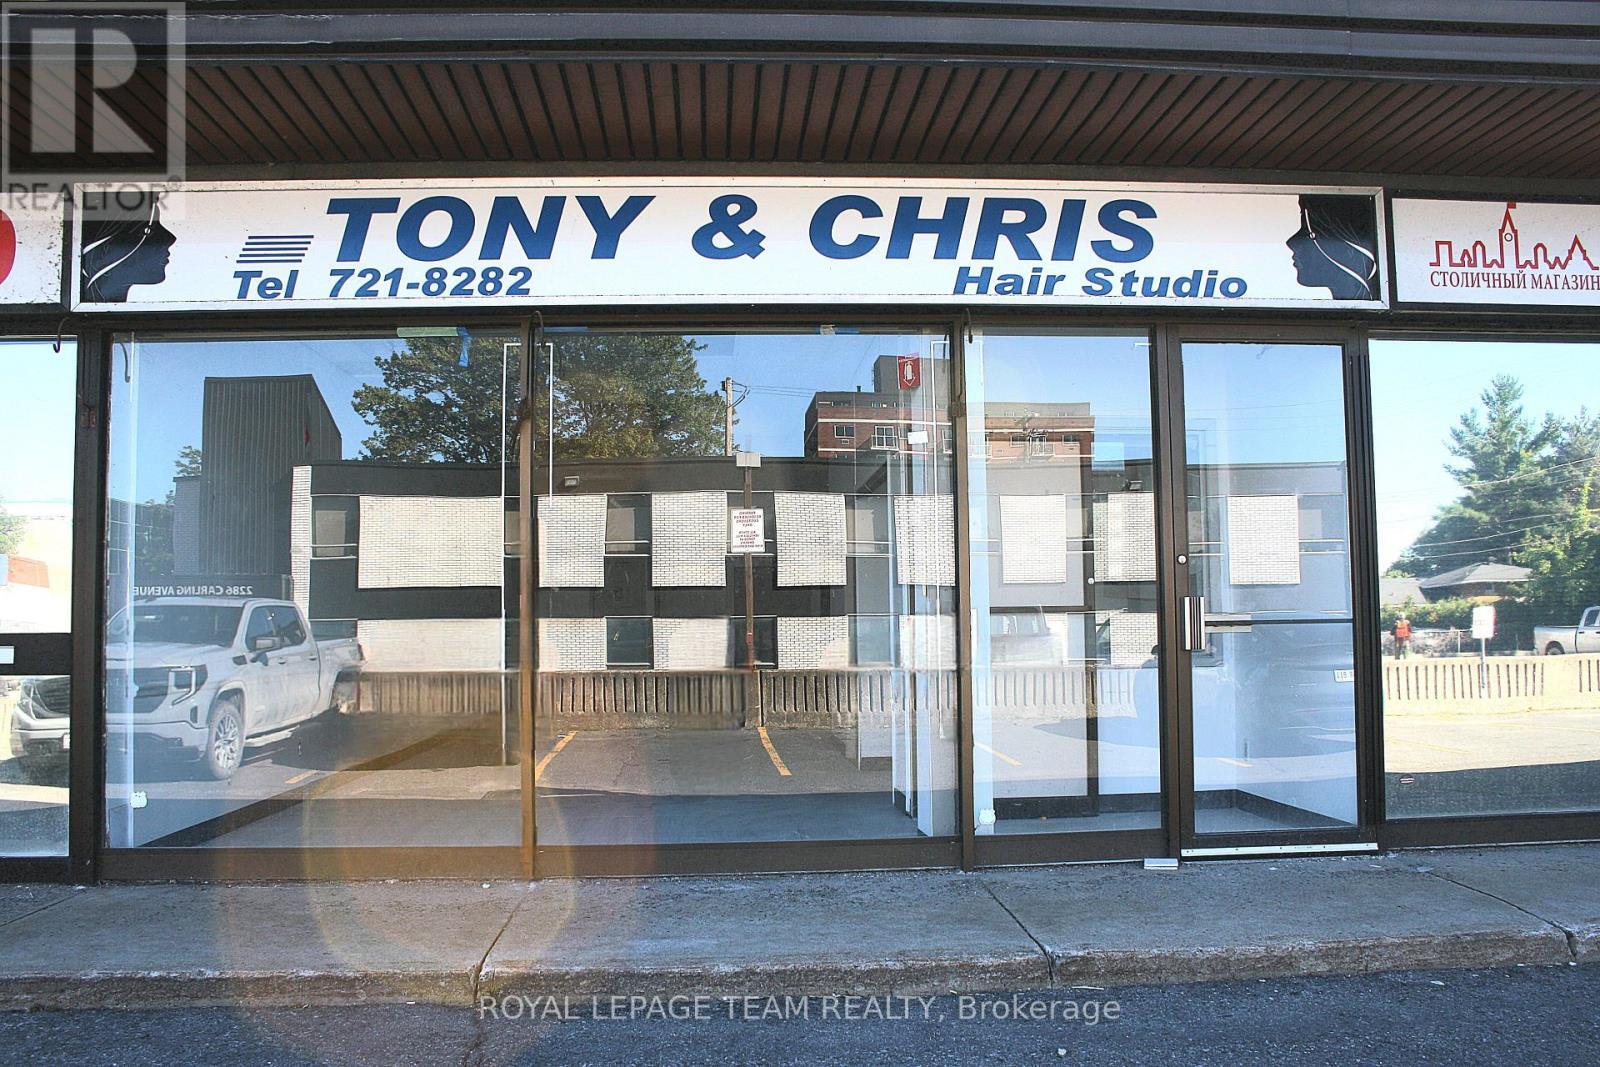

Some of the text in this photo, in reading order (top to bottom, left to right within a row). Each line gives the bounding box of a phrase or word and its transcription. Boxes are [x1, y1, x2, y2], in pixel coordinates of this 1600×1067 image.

[327, 194, 1157, 263] TONY & CHRIS
[233, 267, 533, 299] Tel 721-8282
[953, 266, 1247, 298] Hair Studio
[1430, 270, 1600, 290] СТОЛИЧНЫЙ МАГАЗИН
